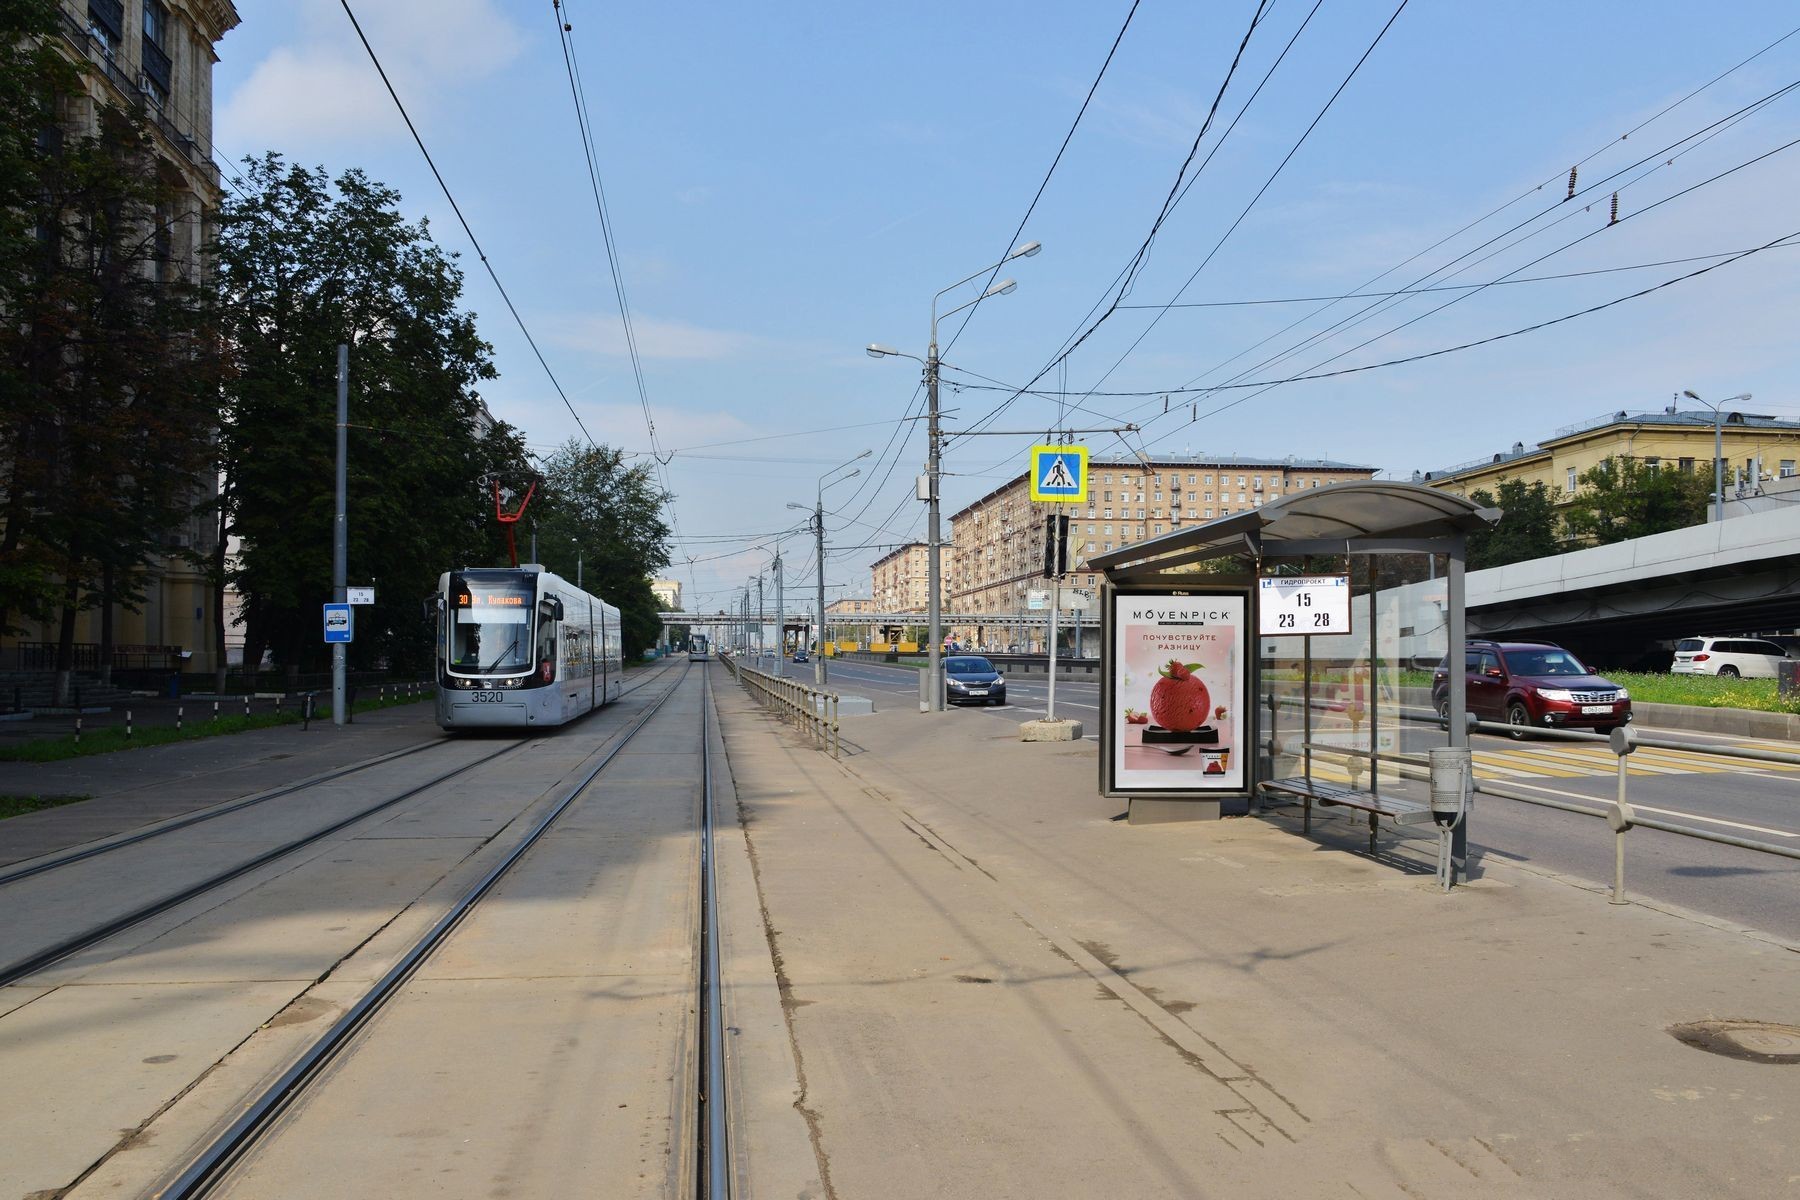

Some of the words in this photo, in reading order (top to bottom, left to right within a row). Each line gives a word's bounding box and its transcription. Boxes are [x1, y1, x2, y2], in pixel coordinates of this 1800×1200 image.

[459, 594, 468, 604] 30
[488, 594, 522, 605] Кулакова
[1296, 593, 1311, 607] 15
[1279, 613, 1294, 628] 23
[1314, 612, 1329, 627] 28
[471, 691, 504, 703] 3520
